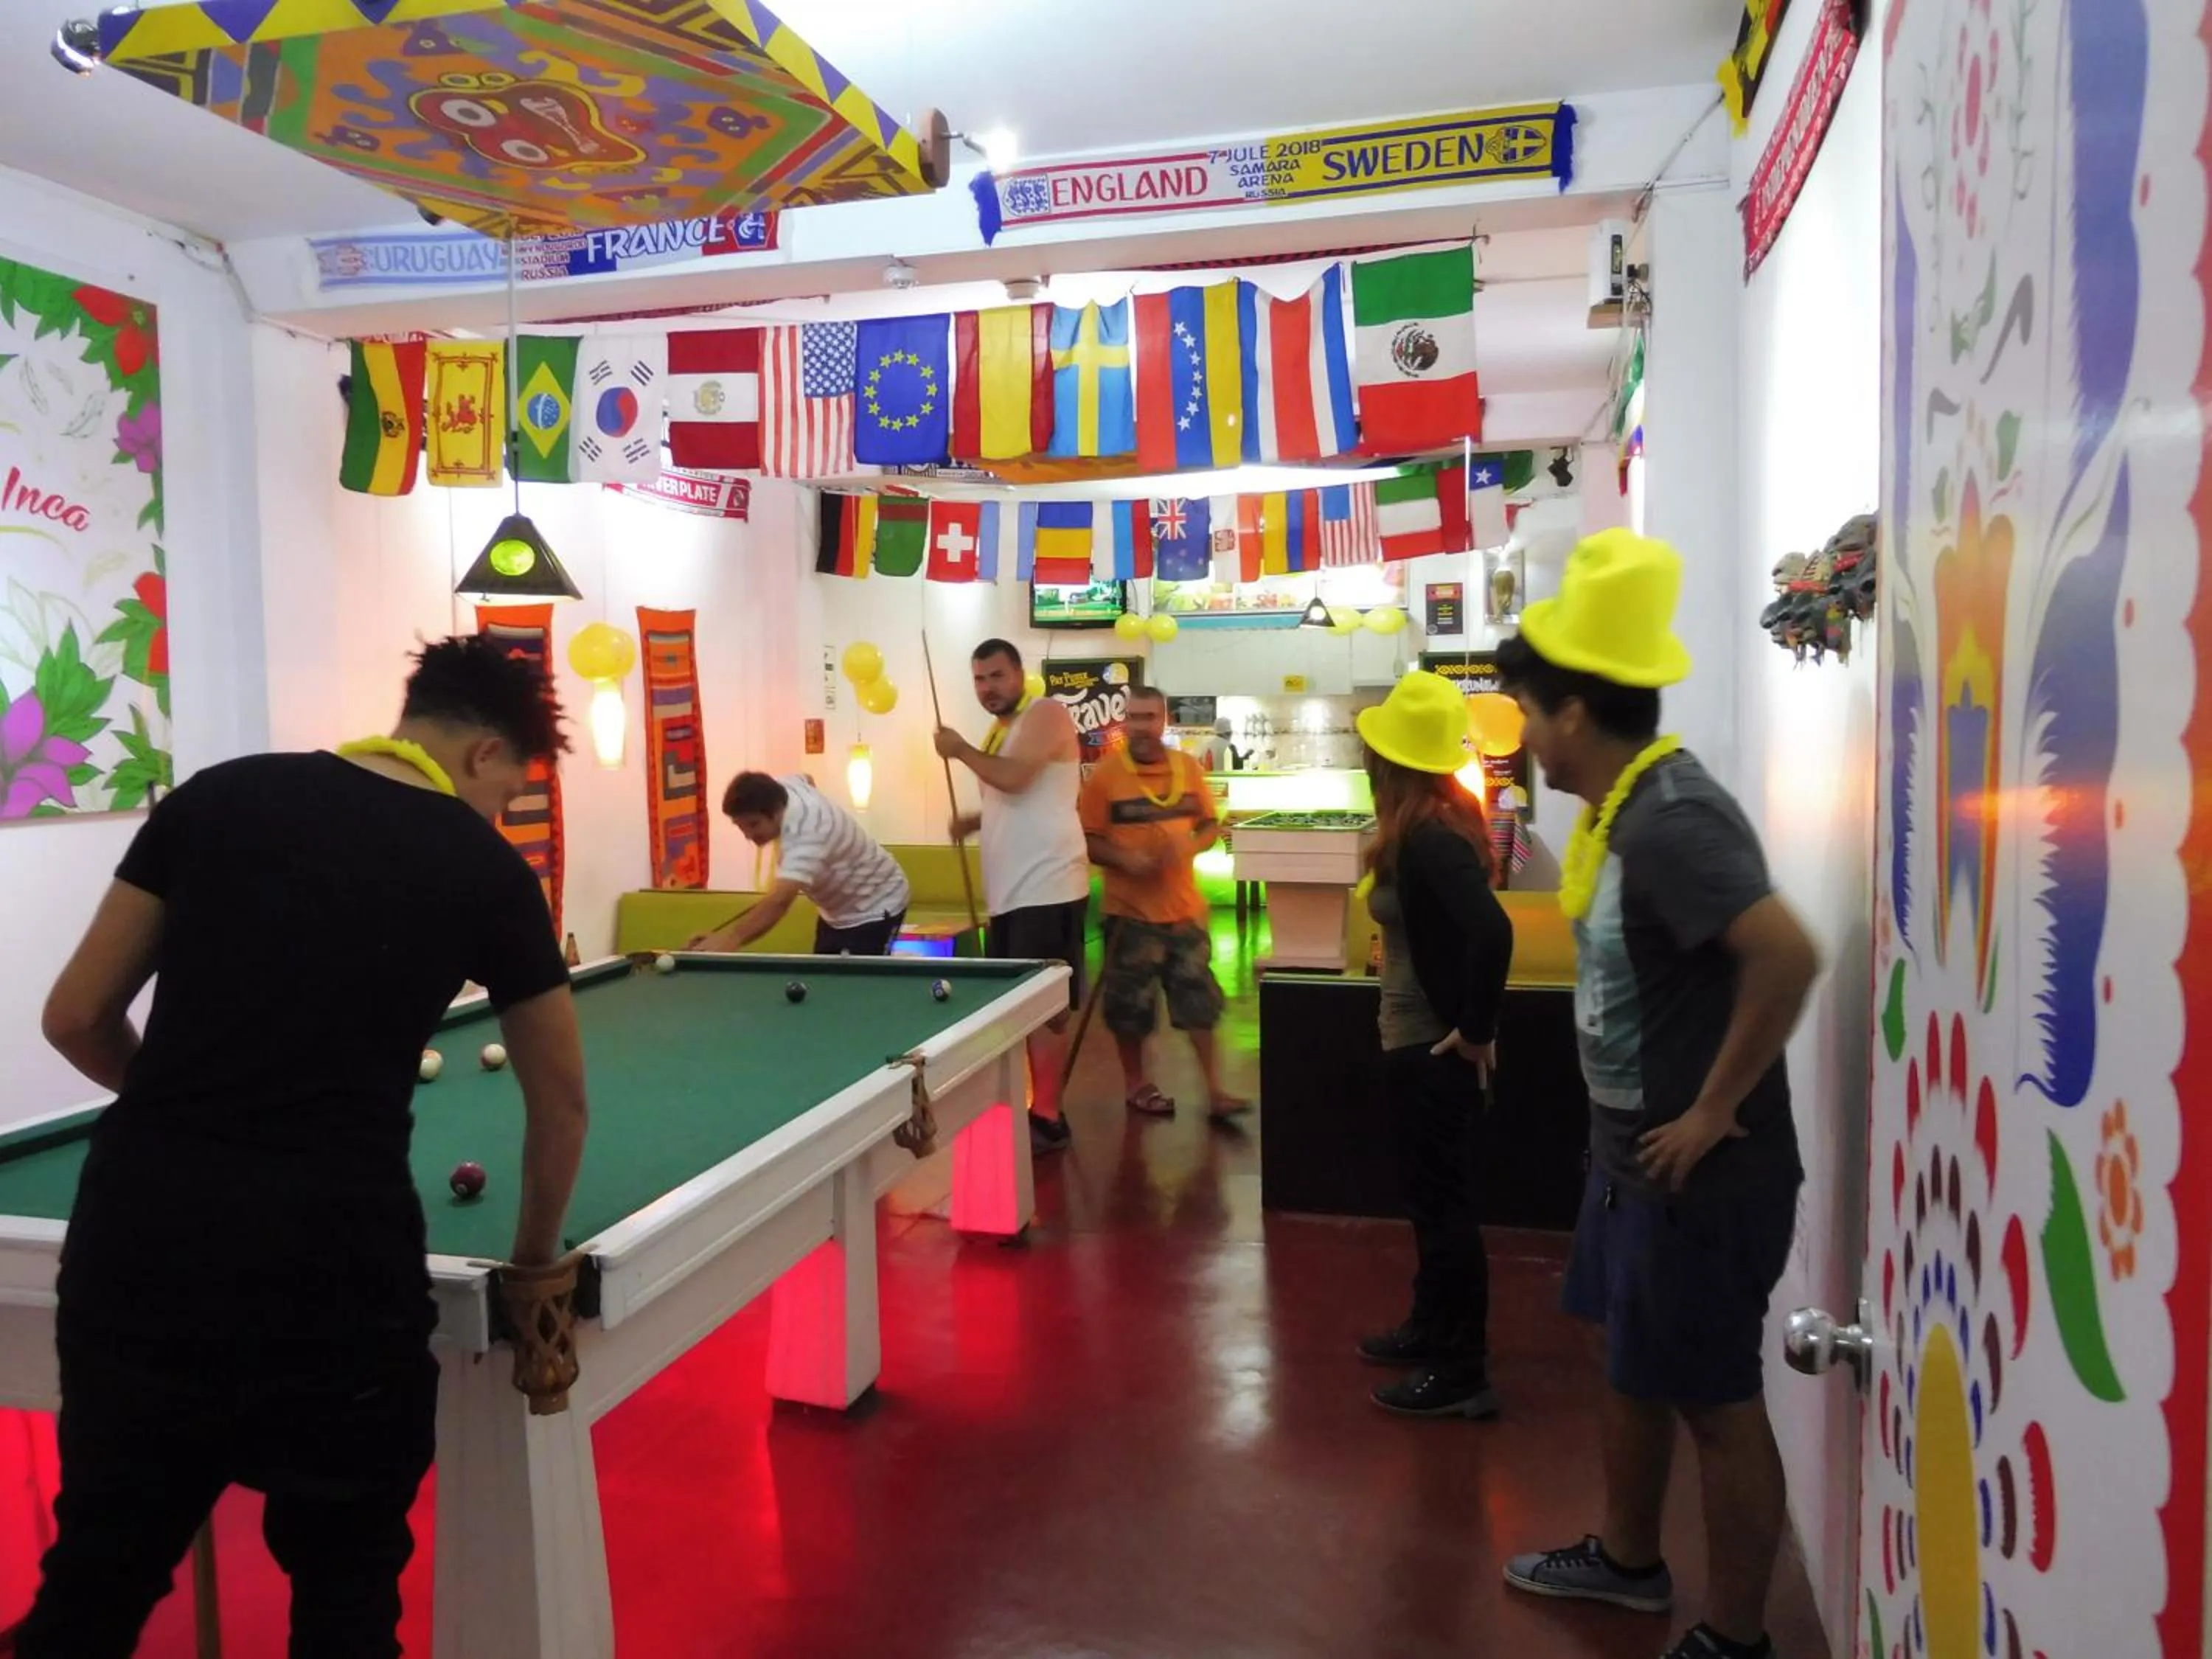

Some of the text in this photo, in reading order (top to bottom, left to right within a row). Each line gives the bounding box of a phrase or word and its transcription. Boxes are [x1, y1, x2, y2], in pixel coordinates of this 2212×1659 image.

[1208, 139, 1321, 164] 7 JULE 2018
[1230, 159, 1301, 176] SAMARA
[1322, 133, 1484, 181] SWEDEN
[1051, 167, 1208, 207] ENGLAND
[1238, 173, 1294, 188] ARENA
[586, 215, 726, 263] FRANCE
[373, 242, 500, 273] URUGUAY
[1, 466, 91, 532] Inca
